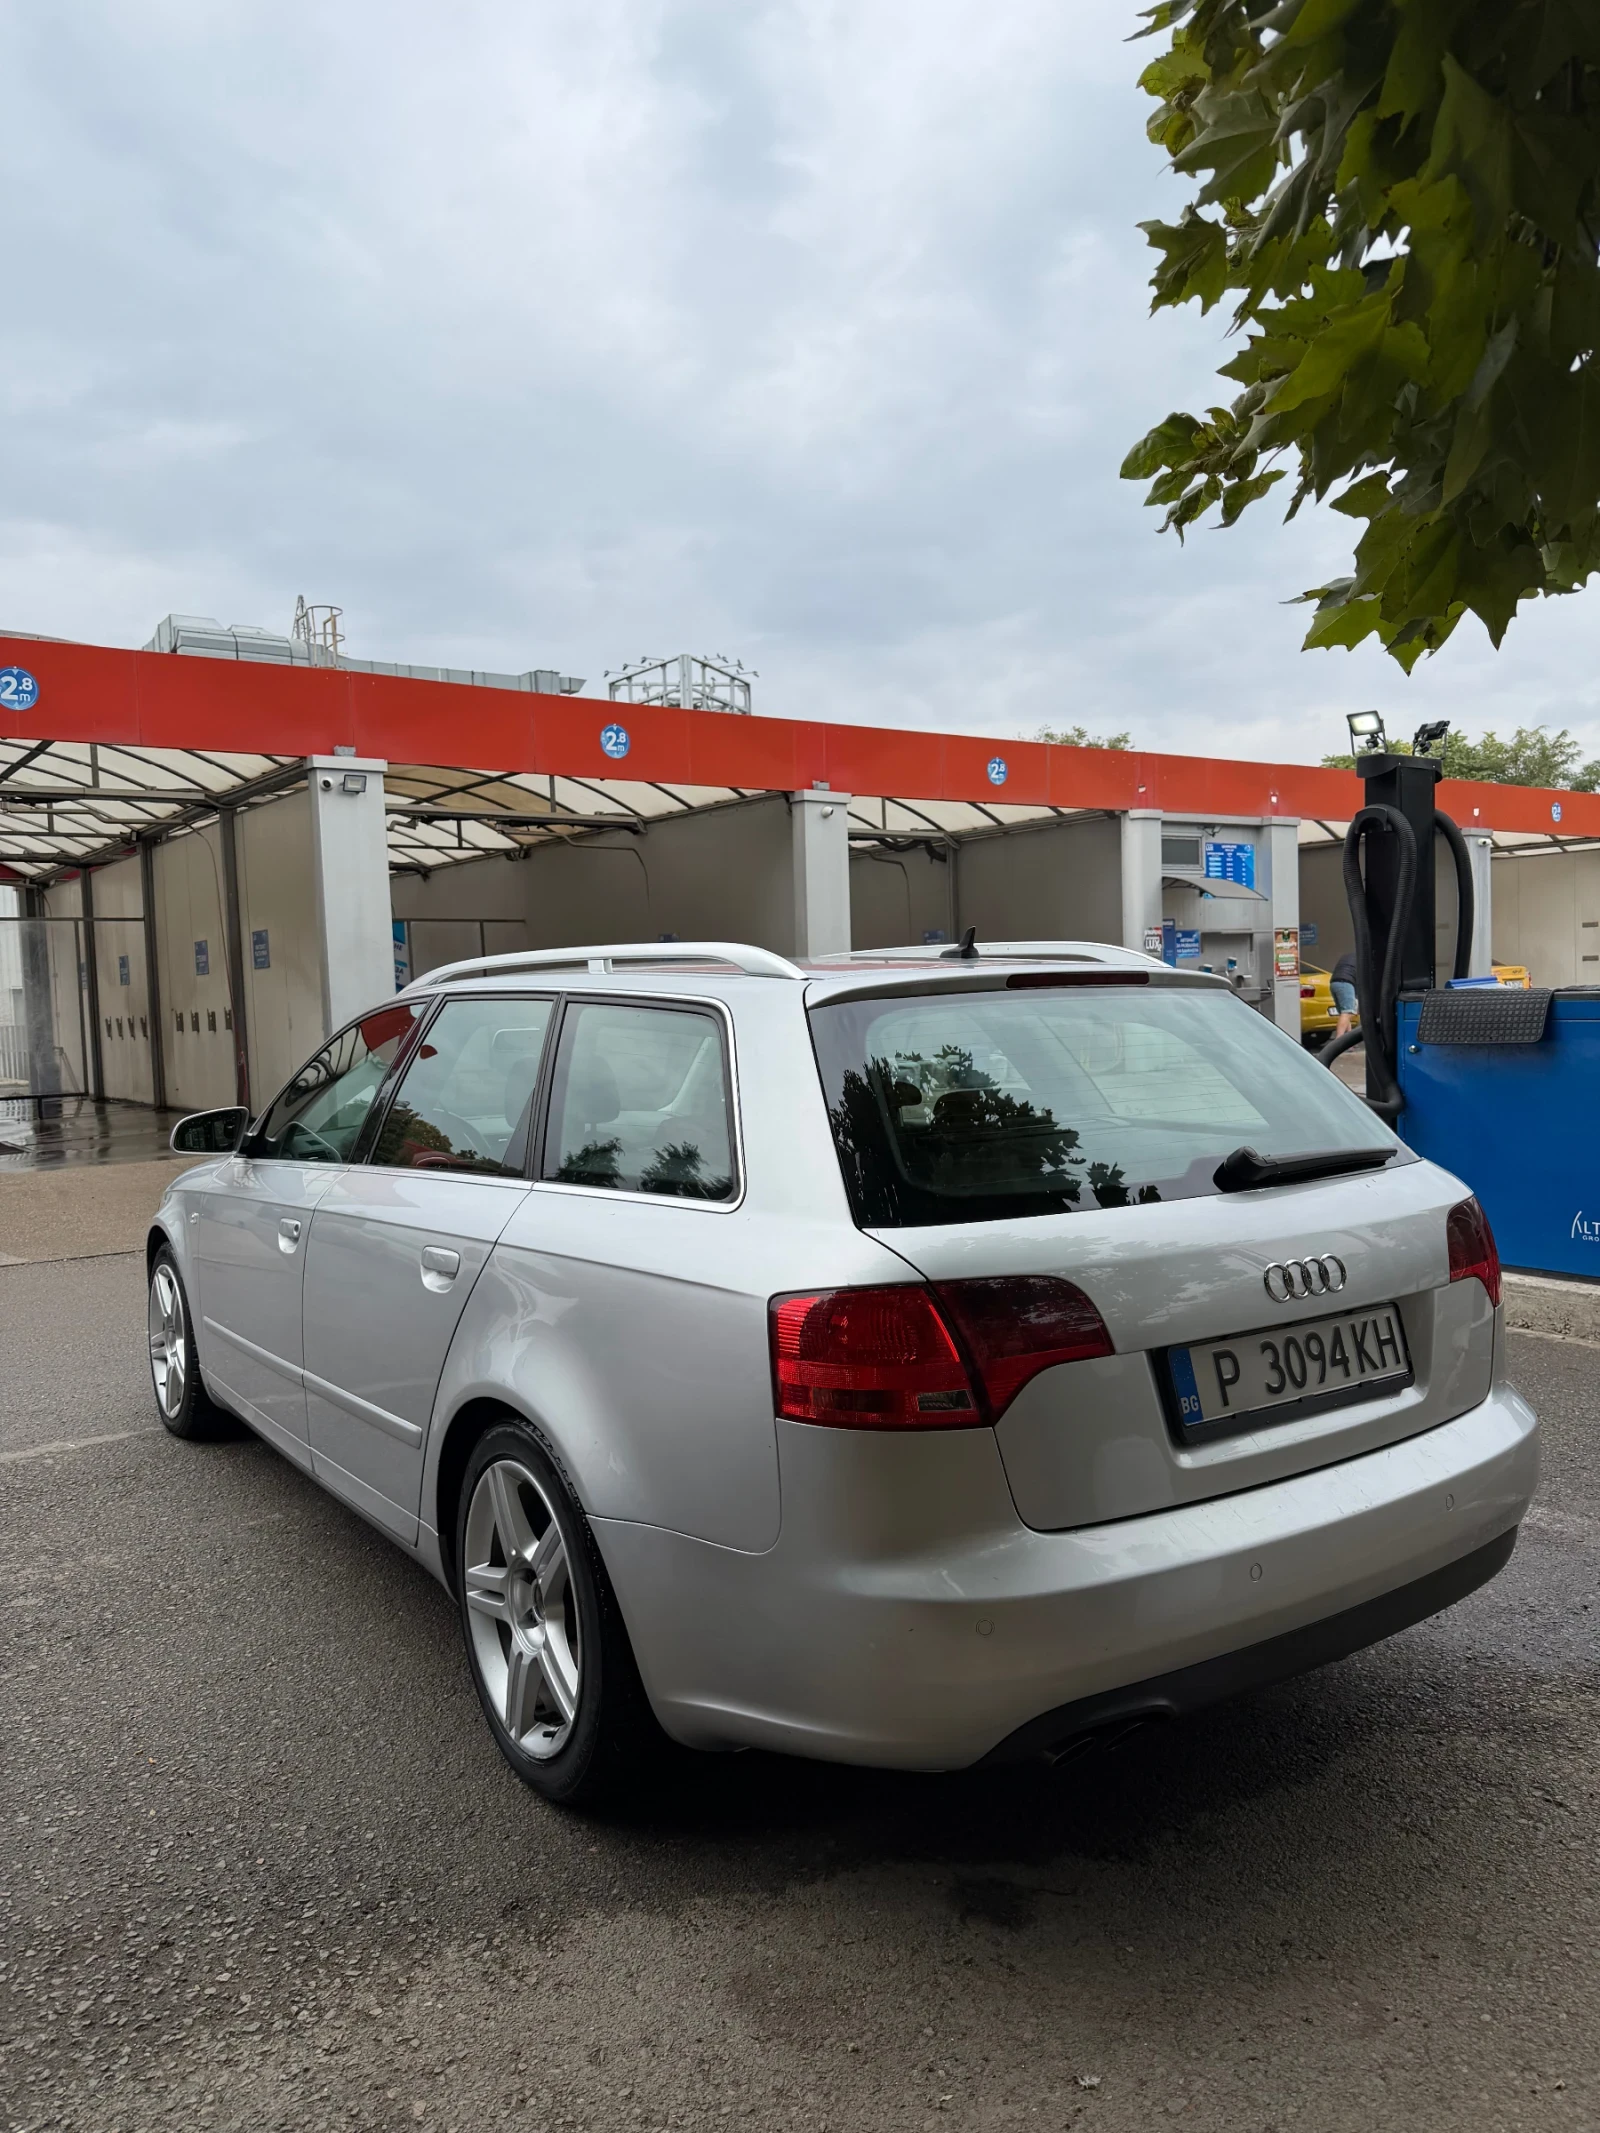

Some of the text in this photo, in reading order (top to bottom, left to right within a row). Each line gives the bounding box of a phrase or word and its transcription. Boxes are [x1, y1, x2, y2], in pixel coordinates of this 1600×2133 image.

[1, 675, 33, 702] 2.8 m
[606, 731, 626, 752] 2.8 m
[1211, 1313, 1401, 1407] P 3094KH
[1180, 1395, 1200, 1415] BG
